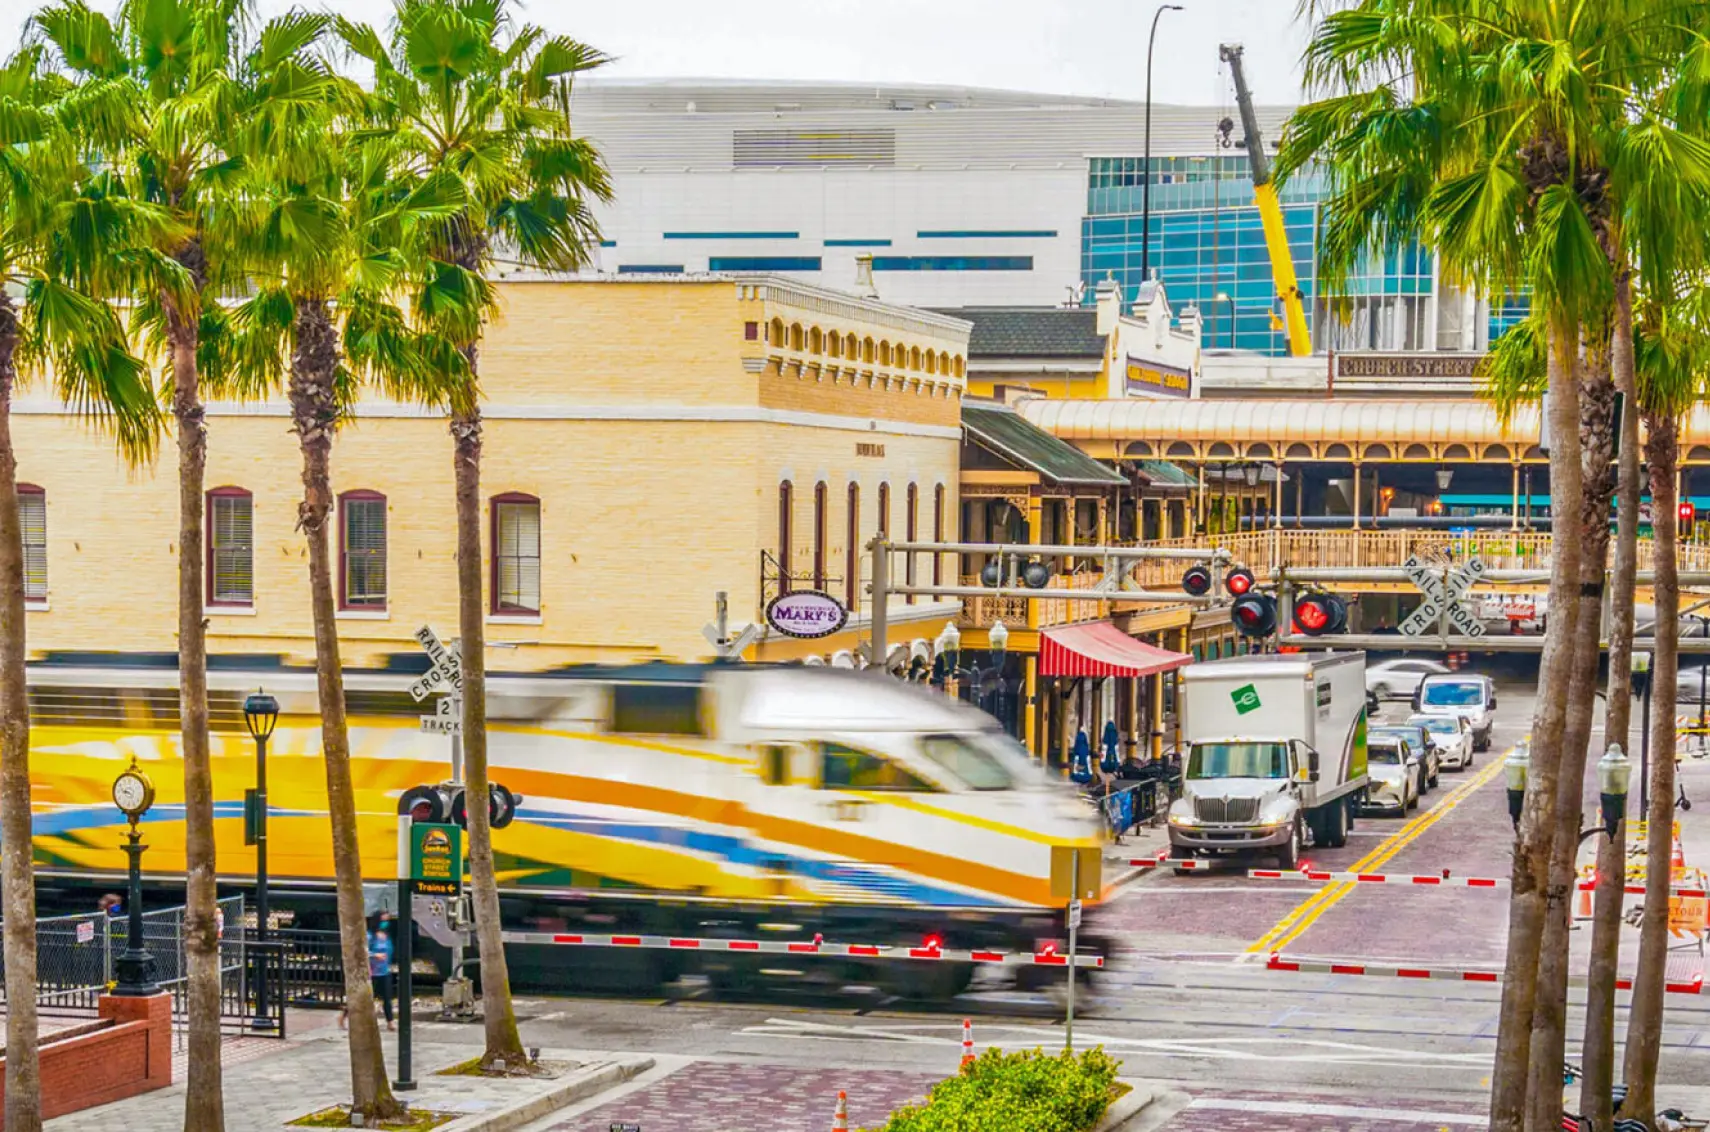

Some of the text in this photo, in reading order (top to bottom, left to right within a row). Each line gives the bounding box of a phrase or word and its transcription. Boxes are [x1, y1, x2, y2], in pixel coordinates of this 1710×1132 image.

[774, 605, 837, 622] MARY'S
[441, 700, 450, 715] 2
[422, 719, 460, 731] TRACK
[417, 881, 446, 893] Trains
